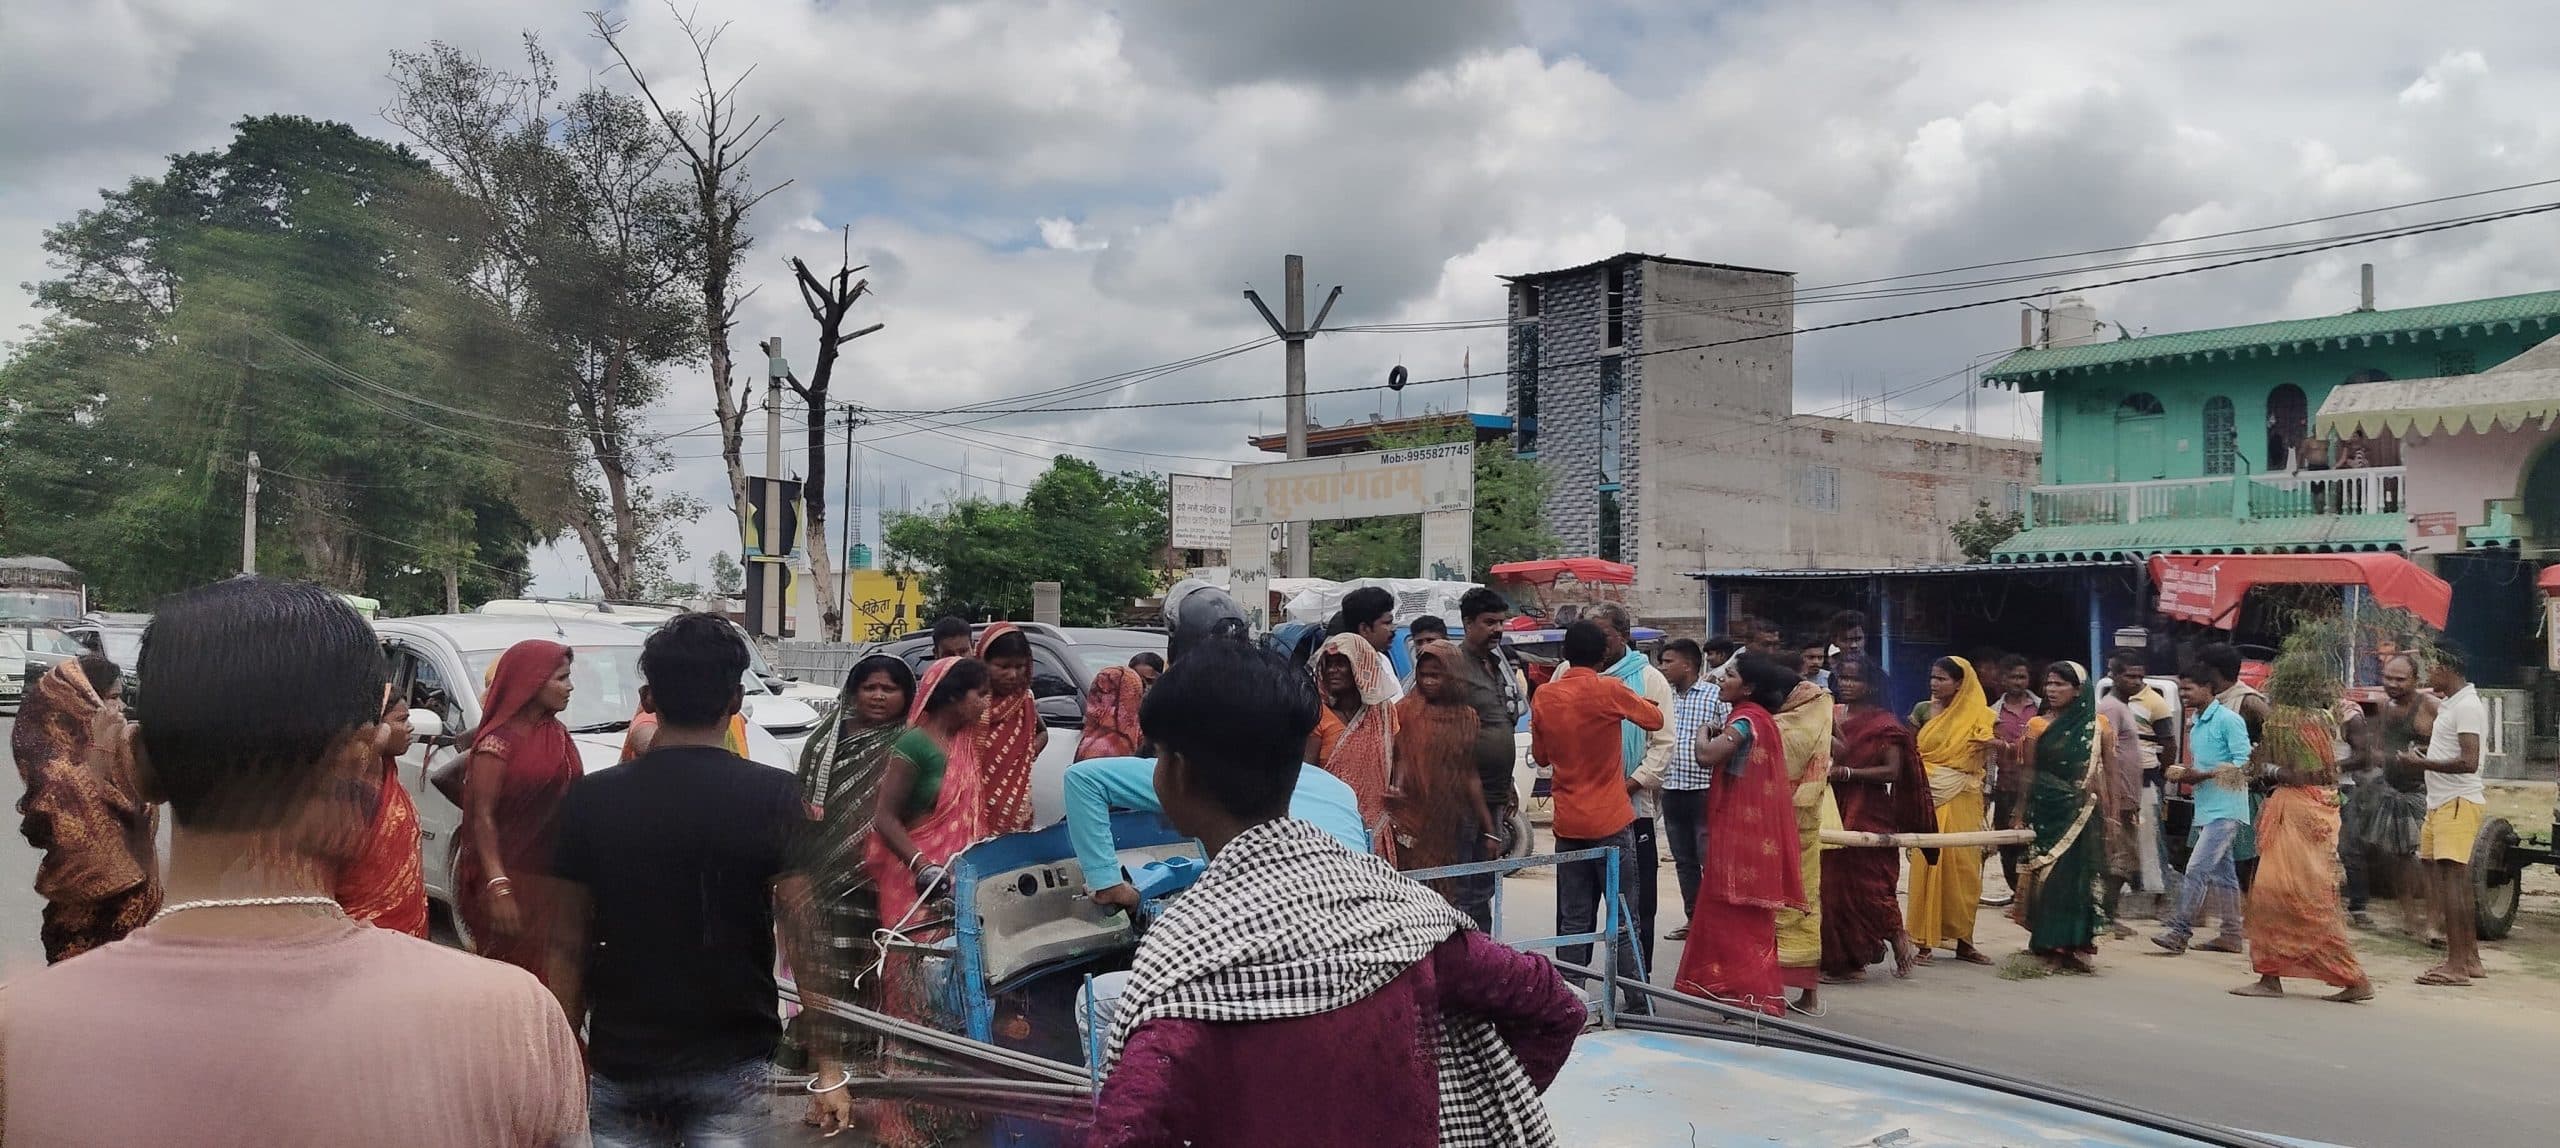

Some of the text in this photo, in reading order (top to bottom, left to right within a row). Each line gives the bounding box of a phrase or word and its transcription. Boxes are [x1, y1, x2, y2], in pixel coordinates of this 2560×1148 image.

[1380, 444, 1470, 465] Mob:-9955827745
[1263, 464, 1433, 518] सुस्वागतम्
[864, 618, 909, 637] स्वती
